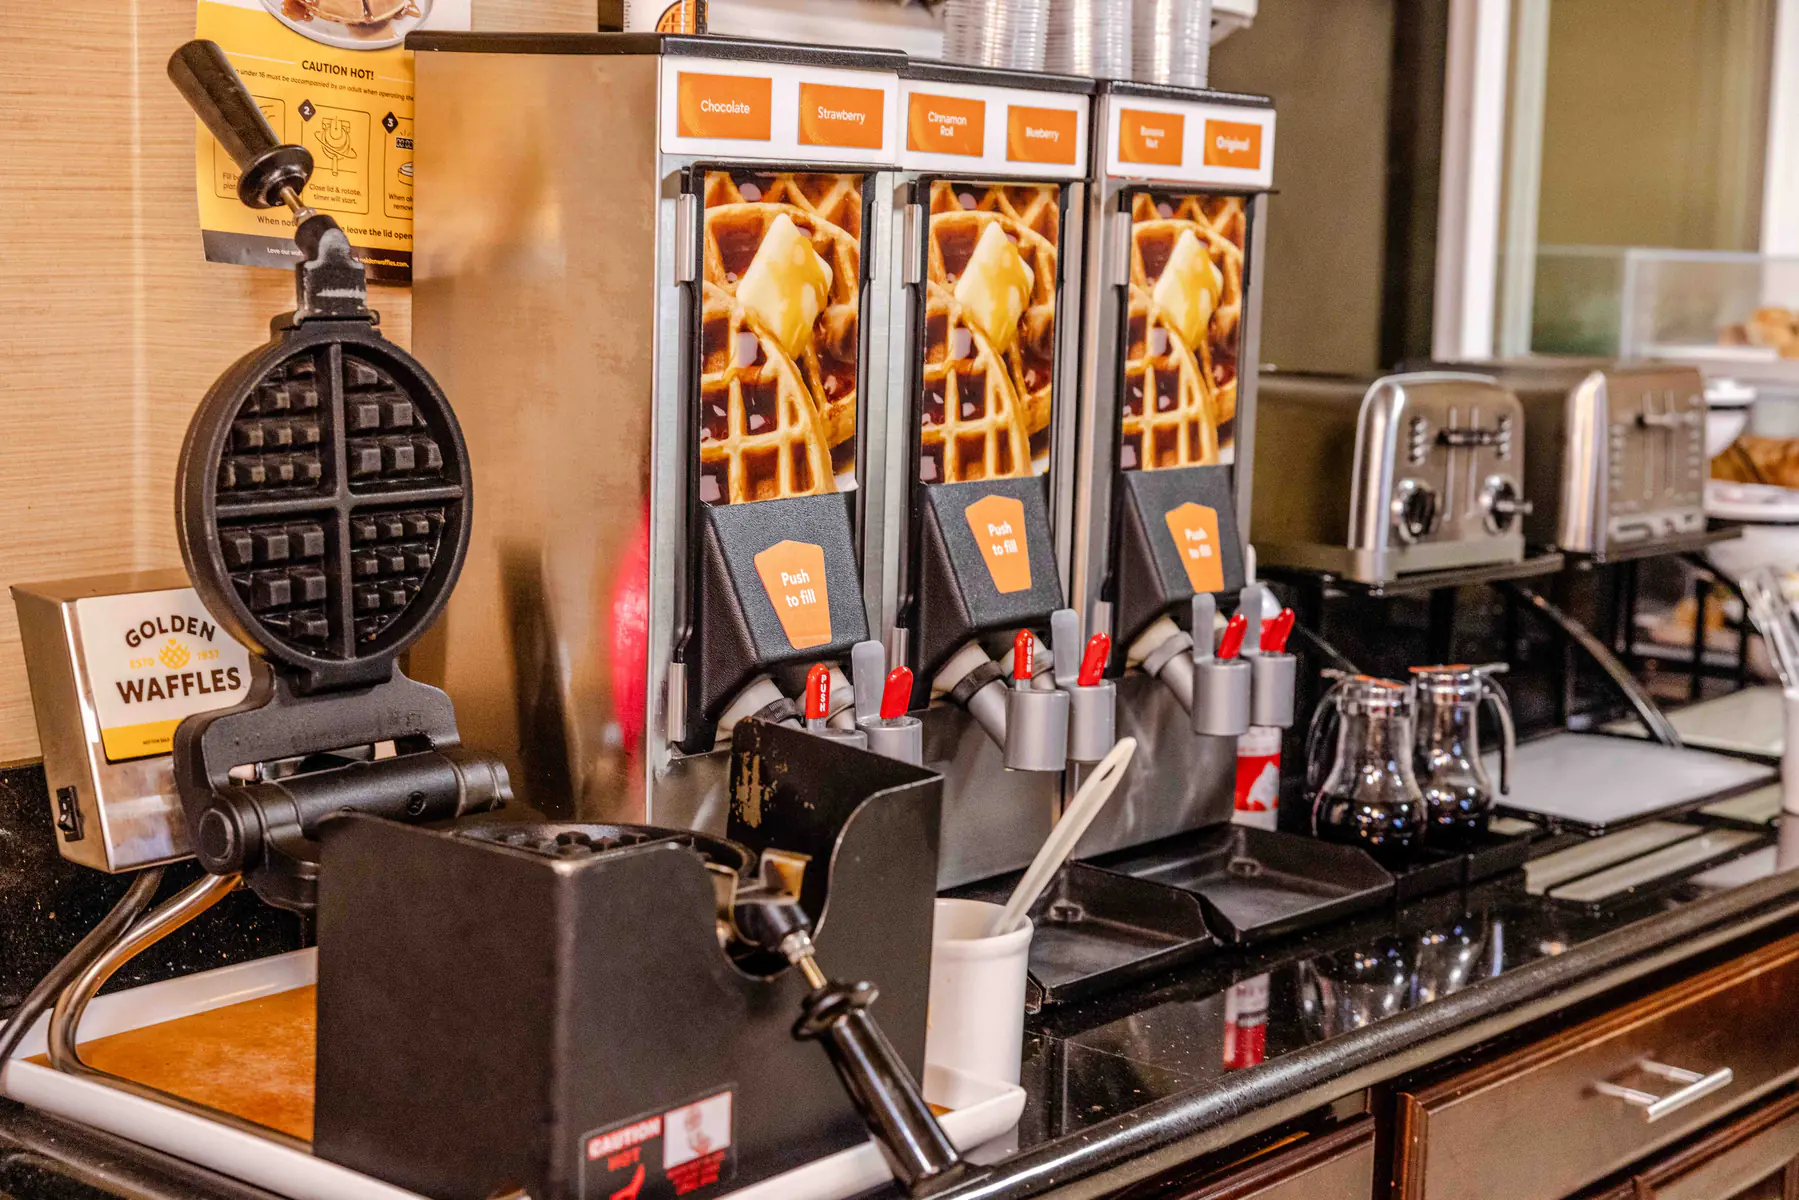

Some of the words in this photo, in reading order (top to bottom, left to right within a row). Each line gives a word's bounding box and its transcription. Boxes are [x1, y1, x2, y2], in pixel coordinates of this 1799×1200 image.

[302, 60, 347, 77] CAUTION
[350, 67, 374, 81] HOT!
[240, 69, 258, 77] under
[266, 73, 281, 81] must
[291, 78, 330, 89] accompanied
[347, 86, 362, 94] adult
[363, 88, 378, 96] when
[379, 91, 405, 102] operating
[700, 97, 751, 114] Chocolate
[387, 118, 394, 128] 3
[817, 105, 866, 125] Strawberry
[927, 111, 967, 126] Cinnamon
[940, 125, 954, 137] Roll
[1026, 126, 1060, 142] Blueberry
[1216, 135, 1250, 153] Original
[222, 172, 231, 180] Fill
[309, 183, 326, 192] Close
[327, 185, 335, 193] lid
[314, 193, 330, 202] timer
[331, 195, 341, 203] will
[388, 193, 403, 202] When
[257, 215, 280, 226] When
[346, 226, 368, 236] leave
[369, 228, 382, 238] the
[383, 230, 393, 239] lid
[267, 247, 280, 255] Love
[987, 521, 1013, 537] Push
[992, 544, 1004, 556] to
[1004, 539, 1018, 554] fill
[781, 568, 810, 587] Push
[786, 594, 800, 608] to
[800, 588, 817, 605] fill
[125, 614, 216, 648] GOLDEN
[129, 657, 155, 670] ESTD
[116, 666, 242, 704] WAFFLES
[820, 674, 828, 712] PUSH
[588, 1116, 661, 1160] CAUTION
